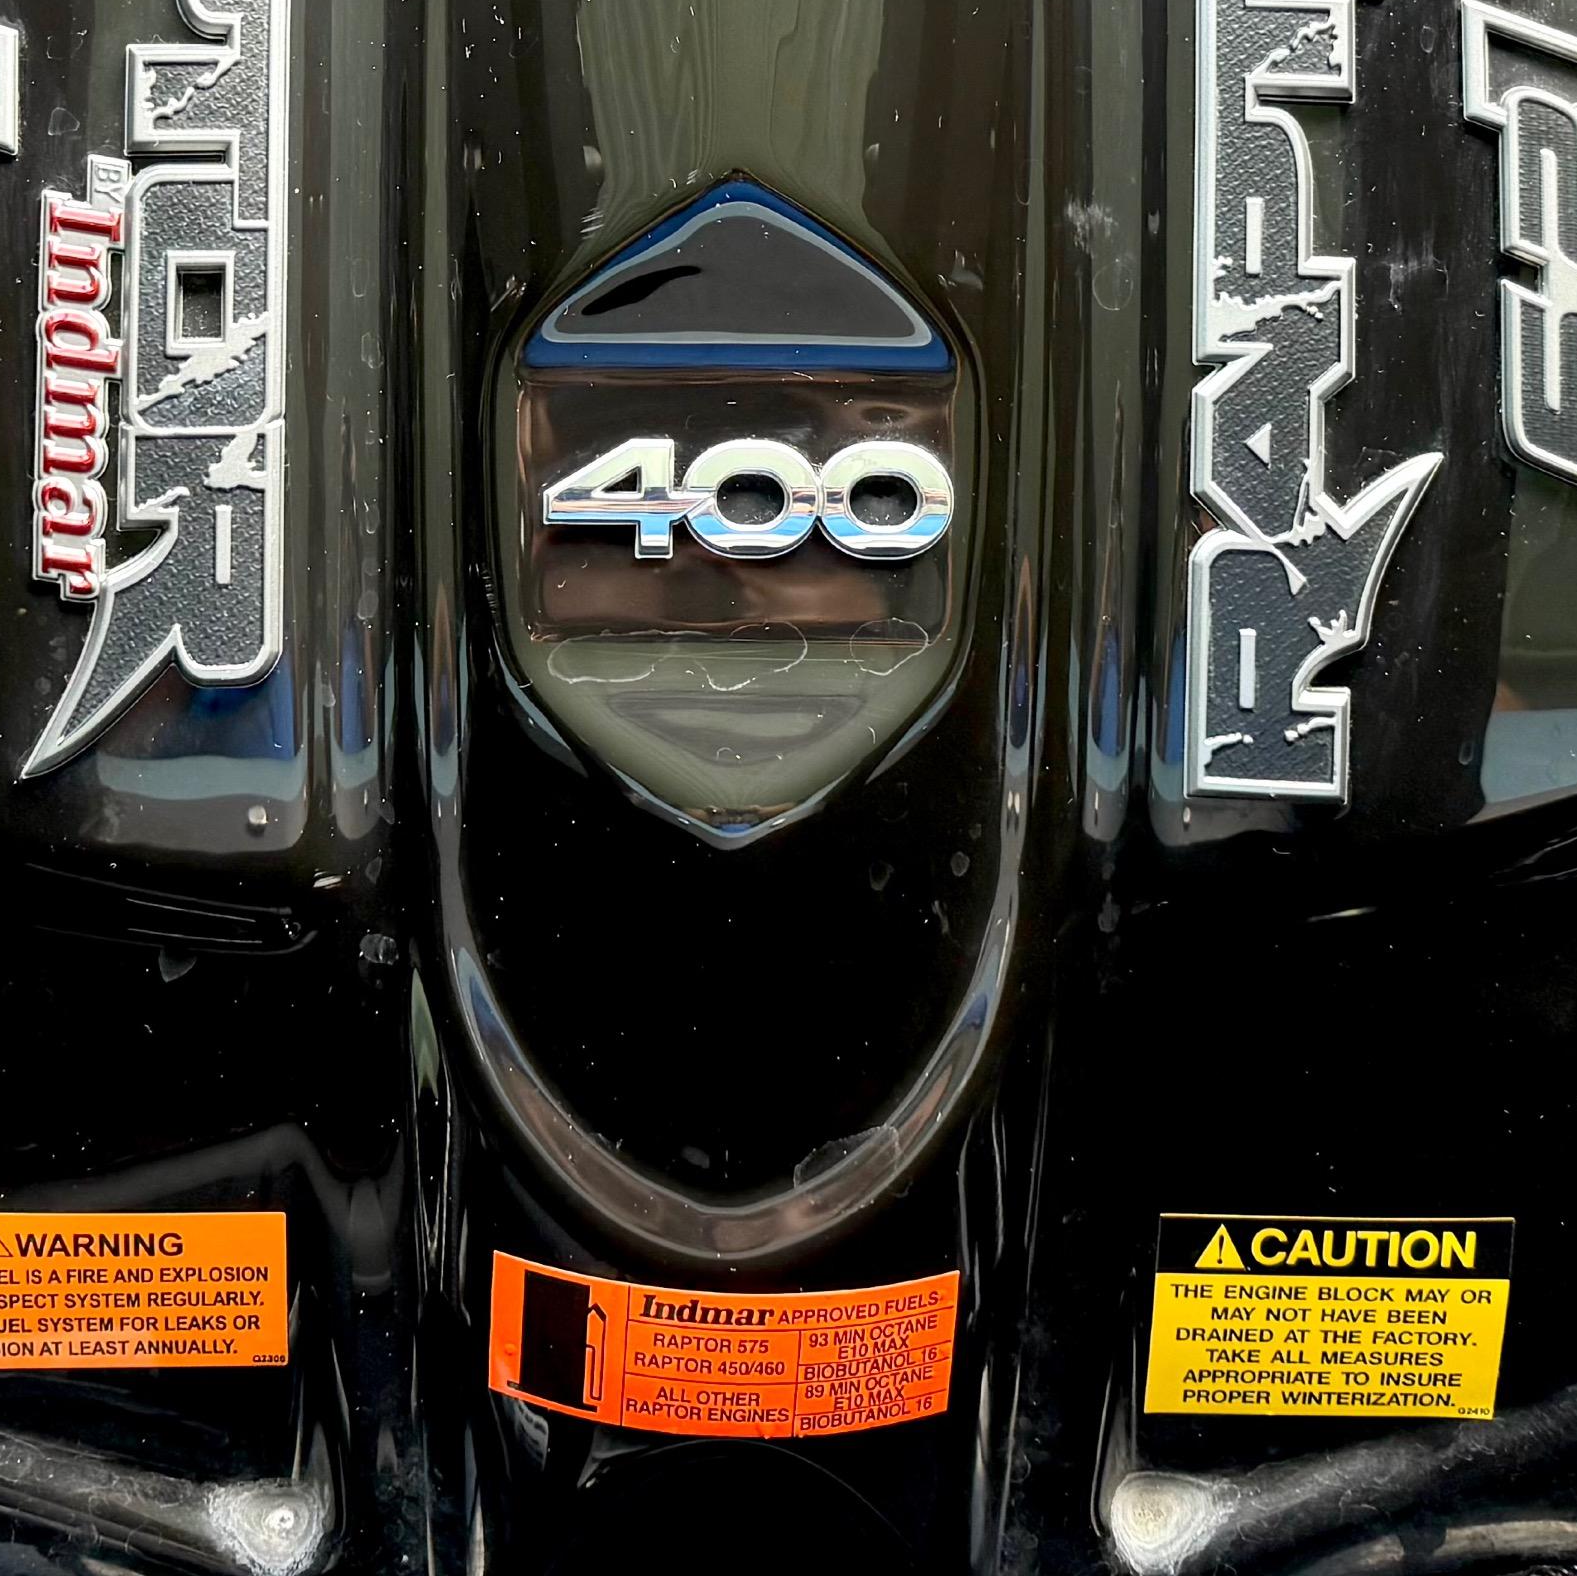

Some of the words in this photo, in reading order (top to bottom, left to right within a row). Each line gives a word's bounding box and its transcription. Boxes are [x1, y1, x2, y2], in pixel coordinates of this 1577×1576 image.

[93, 161, 128, 205] BY
[35, 190, 125, 601] Indmar
[542, 437, 955, 561] 400
[15, 1233, 183, 1257] WARNING
[1251, 1228, 1476, 1268] CAUTION
[26, 1269, 42, 1284] IS
[48, 1269, 62, 1284] A
[66, 1268, 107, 1284] FIRE
[113, 1268, 153, 1283] AND
[159, 1267, 268, 1282] EXPLOSION
[64, 1293, 140, 1309] SYSTEM
[148, 1291, 264, 1307] REGULARLY.
[1171, 1284, 1213, 1298] THE
[1225, 1286, 1307, 1300] ENGINE
[1318, 1287, 1394, 1301] BLOCK
[1405, 1289, 1449, 1303] MAY
[1461, 1290, 1491, 1304] OR
[640, 1295, 774, 1327] Indmar
[778, 1304, 880, 1324] APPROVED
[885, 1291, 939, 1314] FUELS
[1211, 1308, 1255, 1321] MAY
[1266, 1308, 1311, 1322] NOT
[1321, 1309, 1376, 1323] HAVE
[1388, 1310, 1447, 1324] BEEN
[38, 1317, 113, 1332] SYSTEM
[120, 1317, 158, 1332] FOR
[165, 1316, 226, 1331] LEAKS
[233, 1315, 260, 1330] OR
[809, 1332, 829, 1348] 93
[834, 1327, 866, 1345] MIN
[870, 1315, 938, 1339] OCTANE
[39, 1341, 63, 1356] AT
[69, 1341, 129, 1356] LEAST
[134, 1339, 238, 1354] ANNUALLY.
[653, 1333, 732, 1353] RAPTOR
[738, 1340, 768, 1353] 575
[838, 1344, 869, 1359] E10
[873, 1337, 908, 1355] MAX
[1176, 1328, 1274, 1342] DRAINED
[1284, 1330, 1310, 1343] AT
[1320, 1330, 1361, 1344] THE
[1372, 1331, 1477, 1346] FACTORY.
[635, 1353, 713, 1375] RAPTOR
[718, 1361, 785, 1376] 450/460
[804, 1353, 913, 1380] BIOBUTANOL
[922, 1348, 937, 1361] 16
[1206, 1349, 1260, 1363] TAKE
[1271, 1351, 1310, 1364] ALL
[1321, 1351, 1443, 1366] MEASURES
[805, 1384, 824, 1398] 89
[829, 1379, 861, 1396] MIN
[866, 1366, 933, 1391] OCTANE
[1183, 1370, 1330, 1385] APPROPRIATE
[1342, 1372, 1369, 1386] TO
[1381, 1373, 1462, 1387] INSURE
[656, 1387, 691, 1404] ALL
[696, 1390, 760, 1406] OTHER
[833, 1394, 864, 1411] E10
[869, 1387, 904, 1407] MAX
[1183, 1390, 1270, 1404] PROPER
[1282, 1391, 1455, 1406] WINTERIZATION.
[626, 1398, 702, 1421] RAPTOR
[707, 1407, 789, 1423] ENGINES
[800, 1403, 910, 1430] BIOBUTANOL
[916, 1396, 932, 1411] 16
